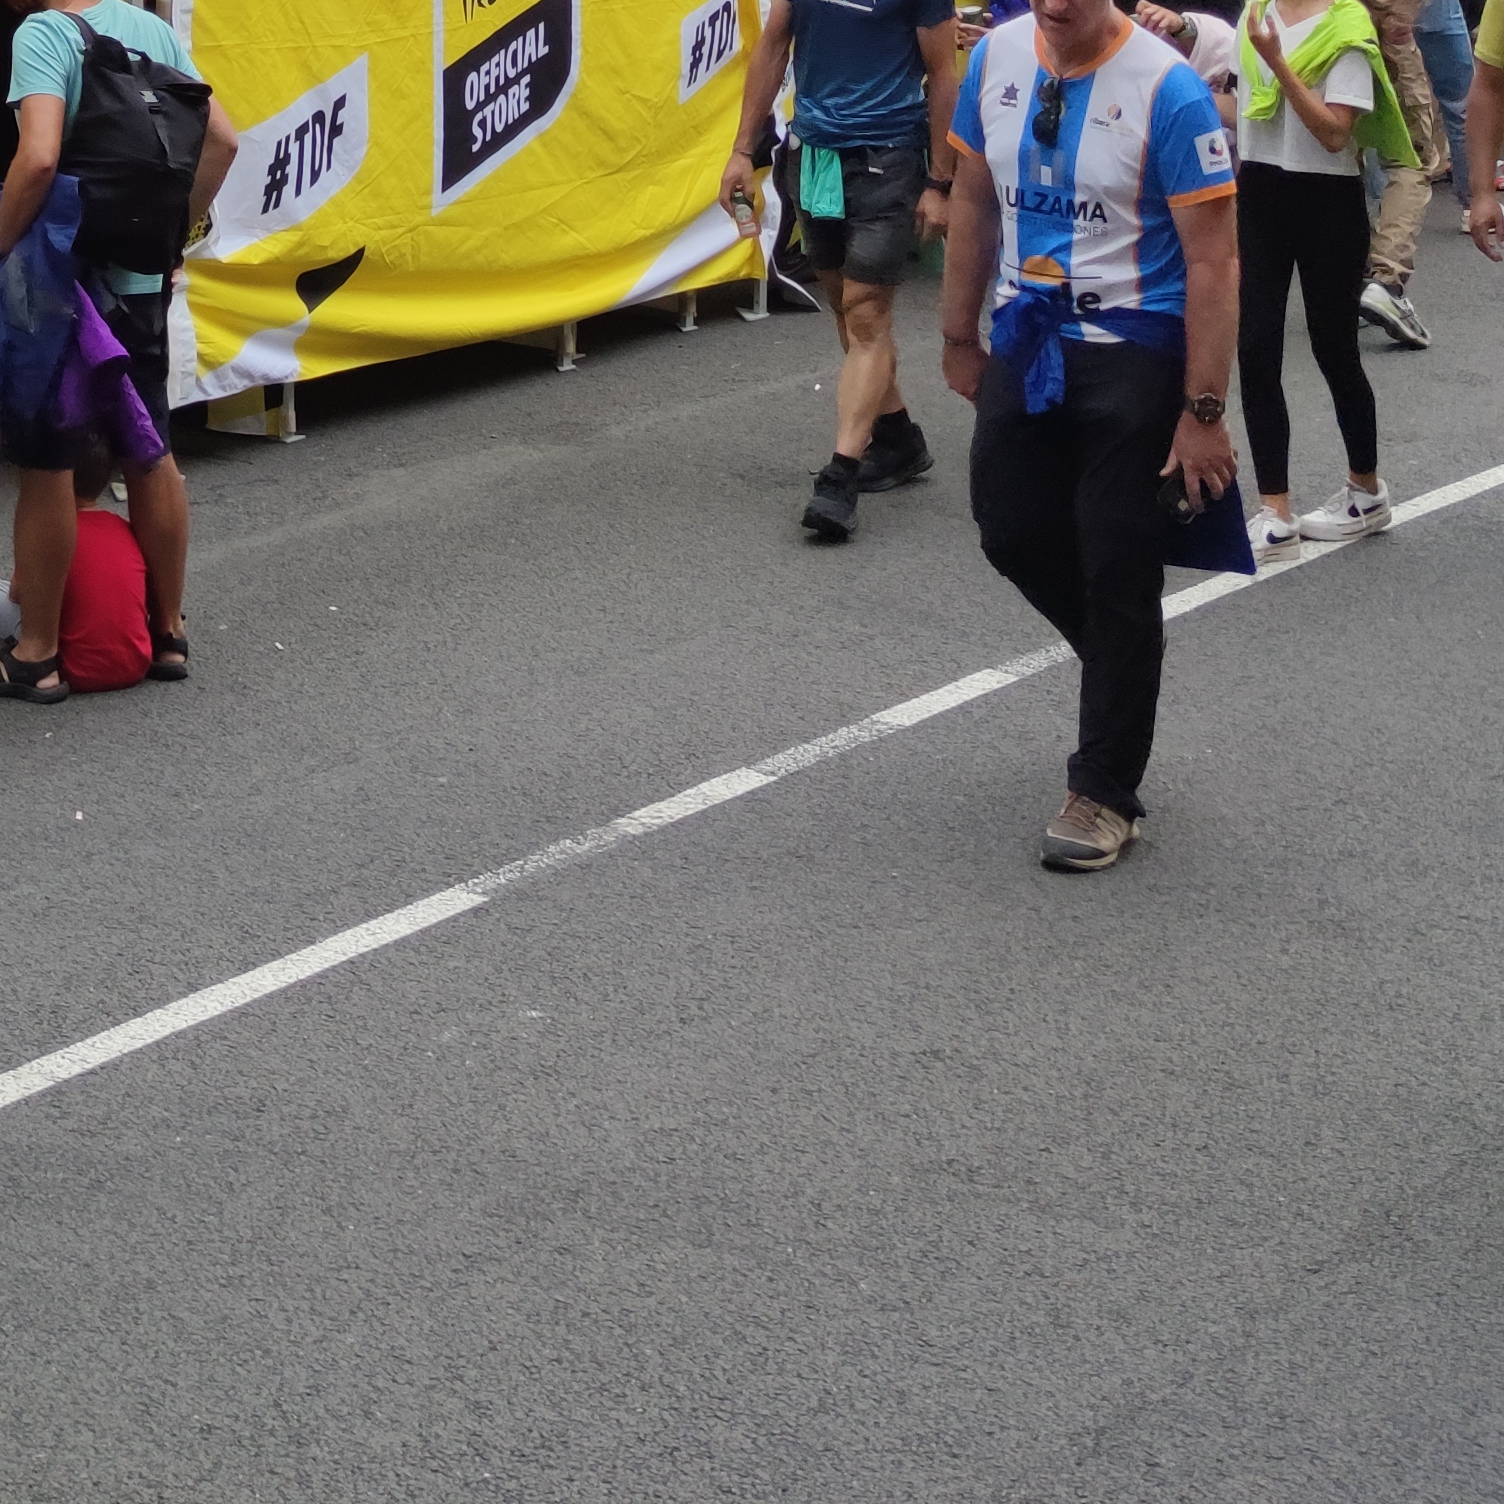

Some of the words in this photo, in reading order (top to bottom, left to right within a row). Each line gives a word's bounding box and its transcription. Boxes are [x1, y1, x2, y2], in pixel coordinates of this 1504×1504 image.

[464, 21, 550, 111] OFFICIAL
[259, 93, 349, 214] #TDF
[471, 83, 531, 154] STORE
[1005, 185, 1108, 224] ULZAMA
